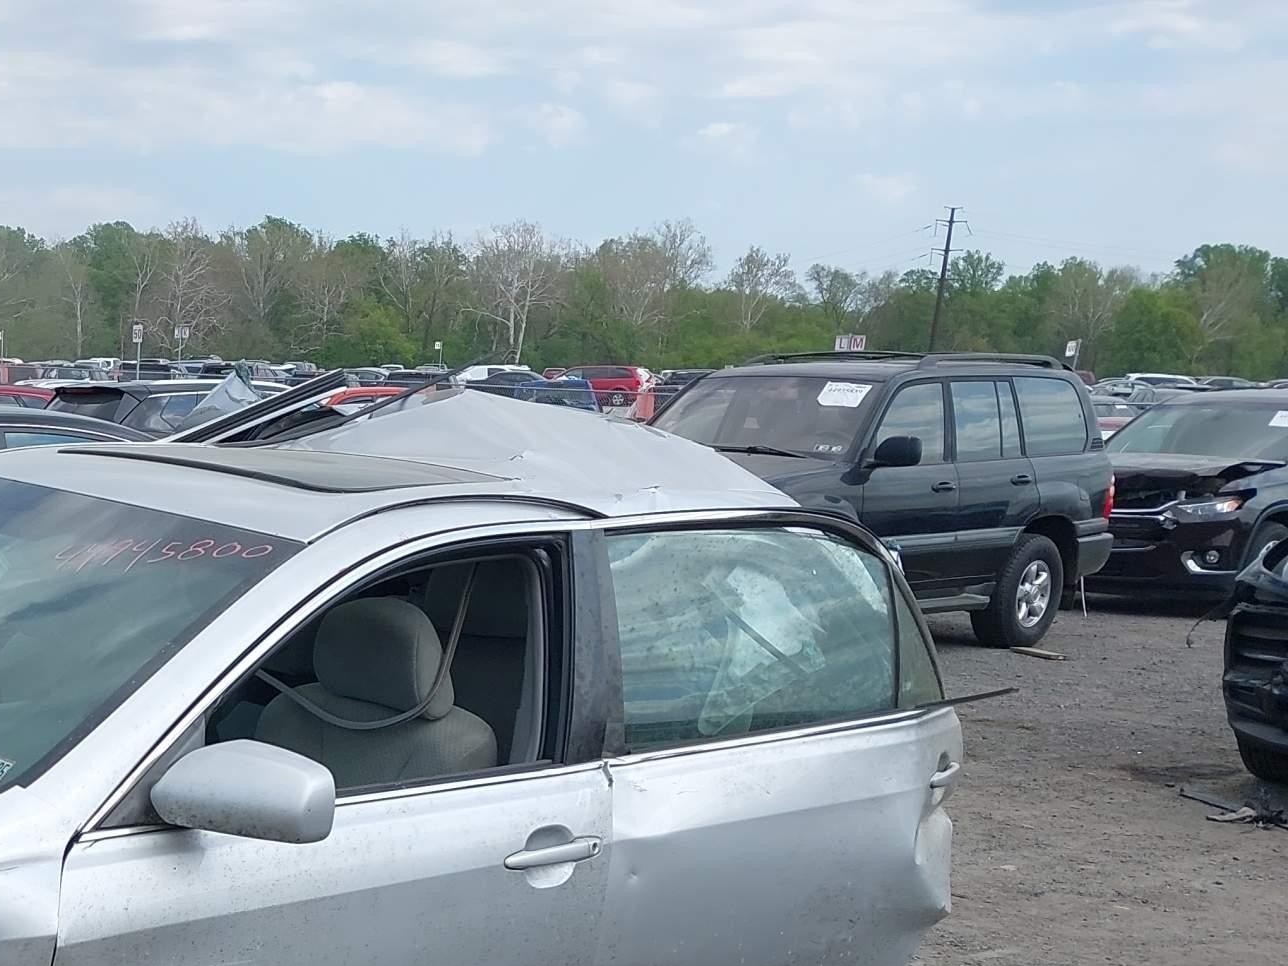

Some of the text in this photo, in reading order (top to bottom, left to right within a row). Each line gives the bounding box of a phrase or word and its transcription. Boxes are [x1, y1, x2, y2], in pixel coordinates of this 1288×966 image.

[133, 328, 142, 340] 50
[839, 337, 846, 349] L
[852, 337, 864, 349] M
